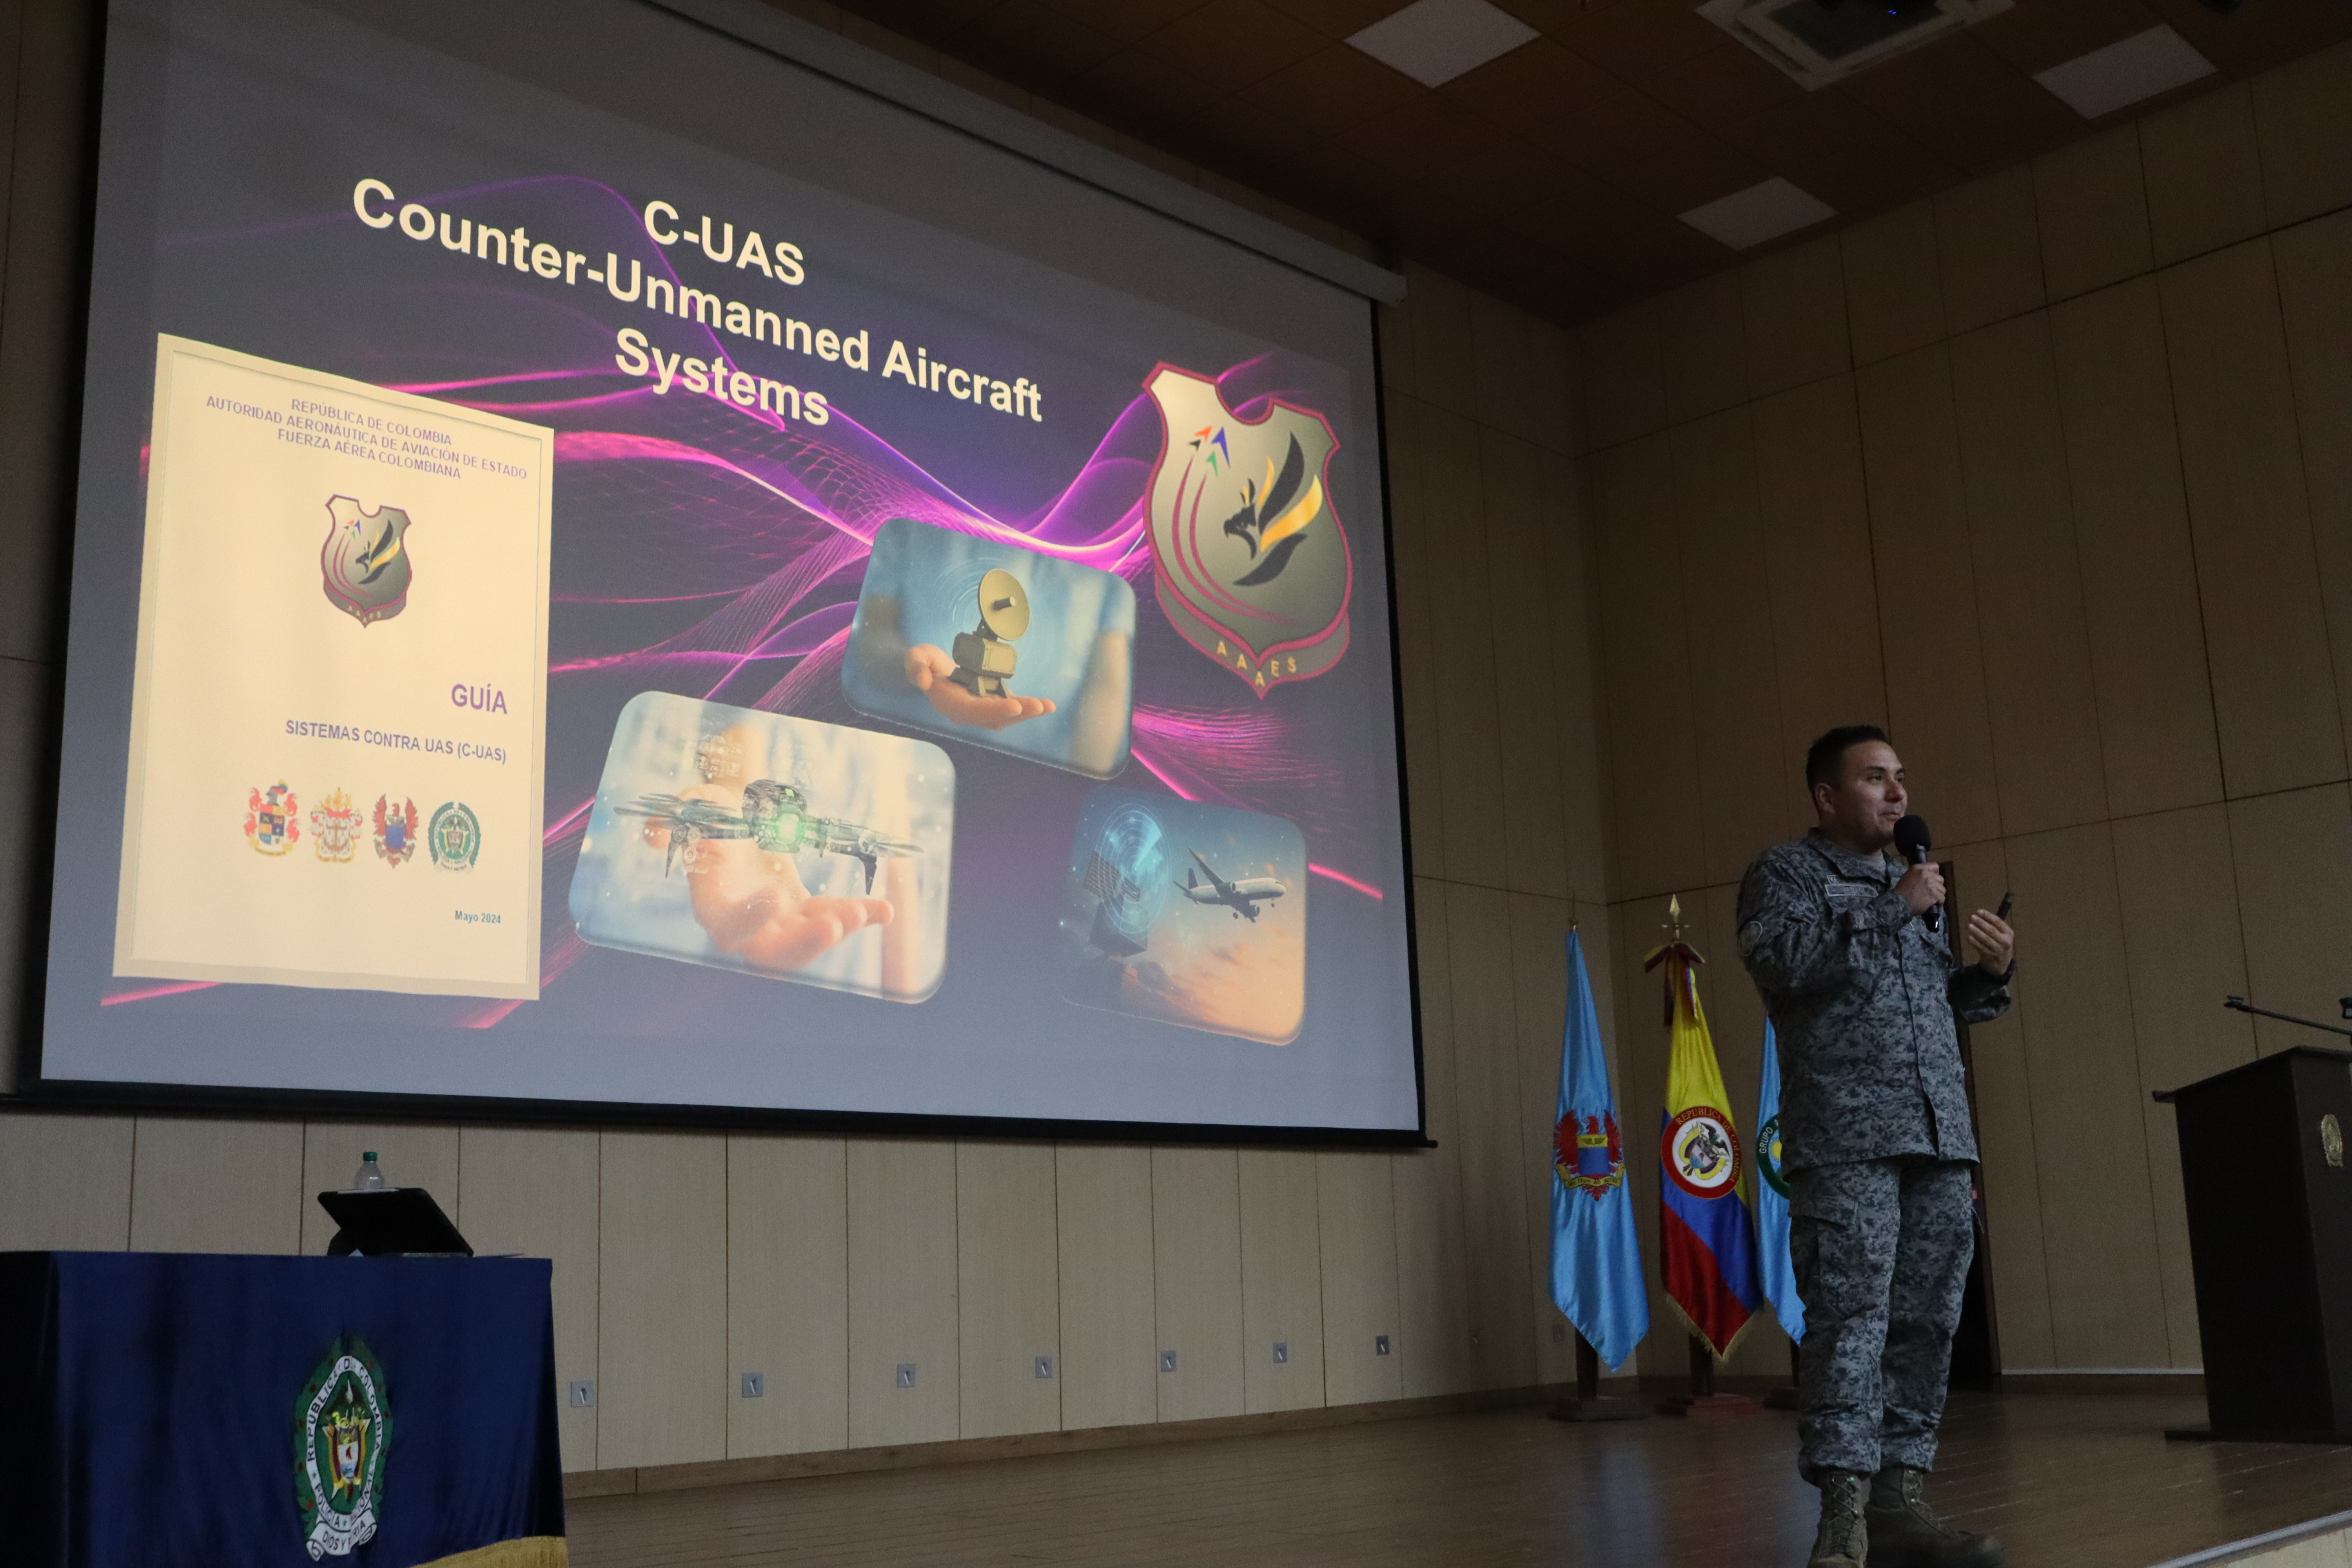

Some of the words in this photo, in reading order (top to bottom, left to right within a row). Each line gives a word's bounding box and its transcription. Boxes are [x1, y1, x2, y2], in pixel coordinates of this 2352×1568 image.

[644, 200, 805, 285] C-UAS
[353, 178, 868, 372] Counter-Unmanned
[882, 340, 1043, 422] Aircraft
[616, 328, 830, 426] Systems
[207, 396, 282, 423] AUTORIDAD
[286, 415, 377, 445] AERONÁUTICA
[382, 436, 397, 450] DE
[401, 441, 459, 463] AVIACIÓN
[463, 454, 477, 468] DE
[482, 459, 527, 479] ESTADO
[291, 399, 364, 426] REPÚBLICA
[367, 417, 383, 430] DE
[387, 422, 451, 445] COLOMBIA
[278, 428, 330, 449] FUERZA
[334, 439, 375, 460] AÉREA
[379, 452, 461, 479] COLOMBIANA
[451, 683, 508, 715] GUÍA
[286, 720, 360, 741] SISTEMAS
[364, 730, 420, 751] CONTRA
[425, 739, 454, 755] UAS
[457, 742, 506, 765] (C-UAS)
[455, 910, 478, 924] Mayo
[481, 913, 501, 924] 2024
[1759, 1126, 1773, 1154] GRUPO
[322, 1530, 339, 1550] DIOS
[341, 1539, 346, 1550] Y
